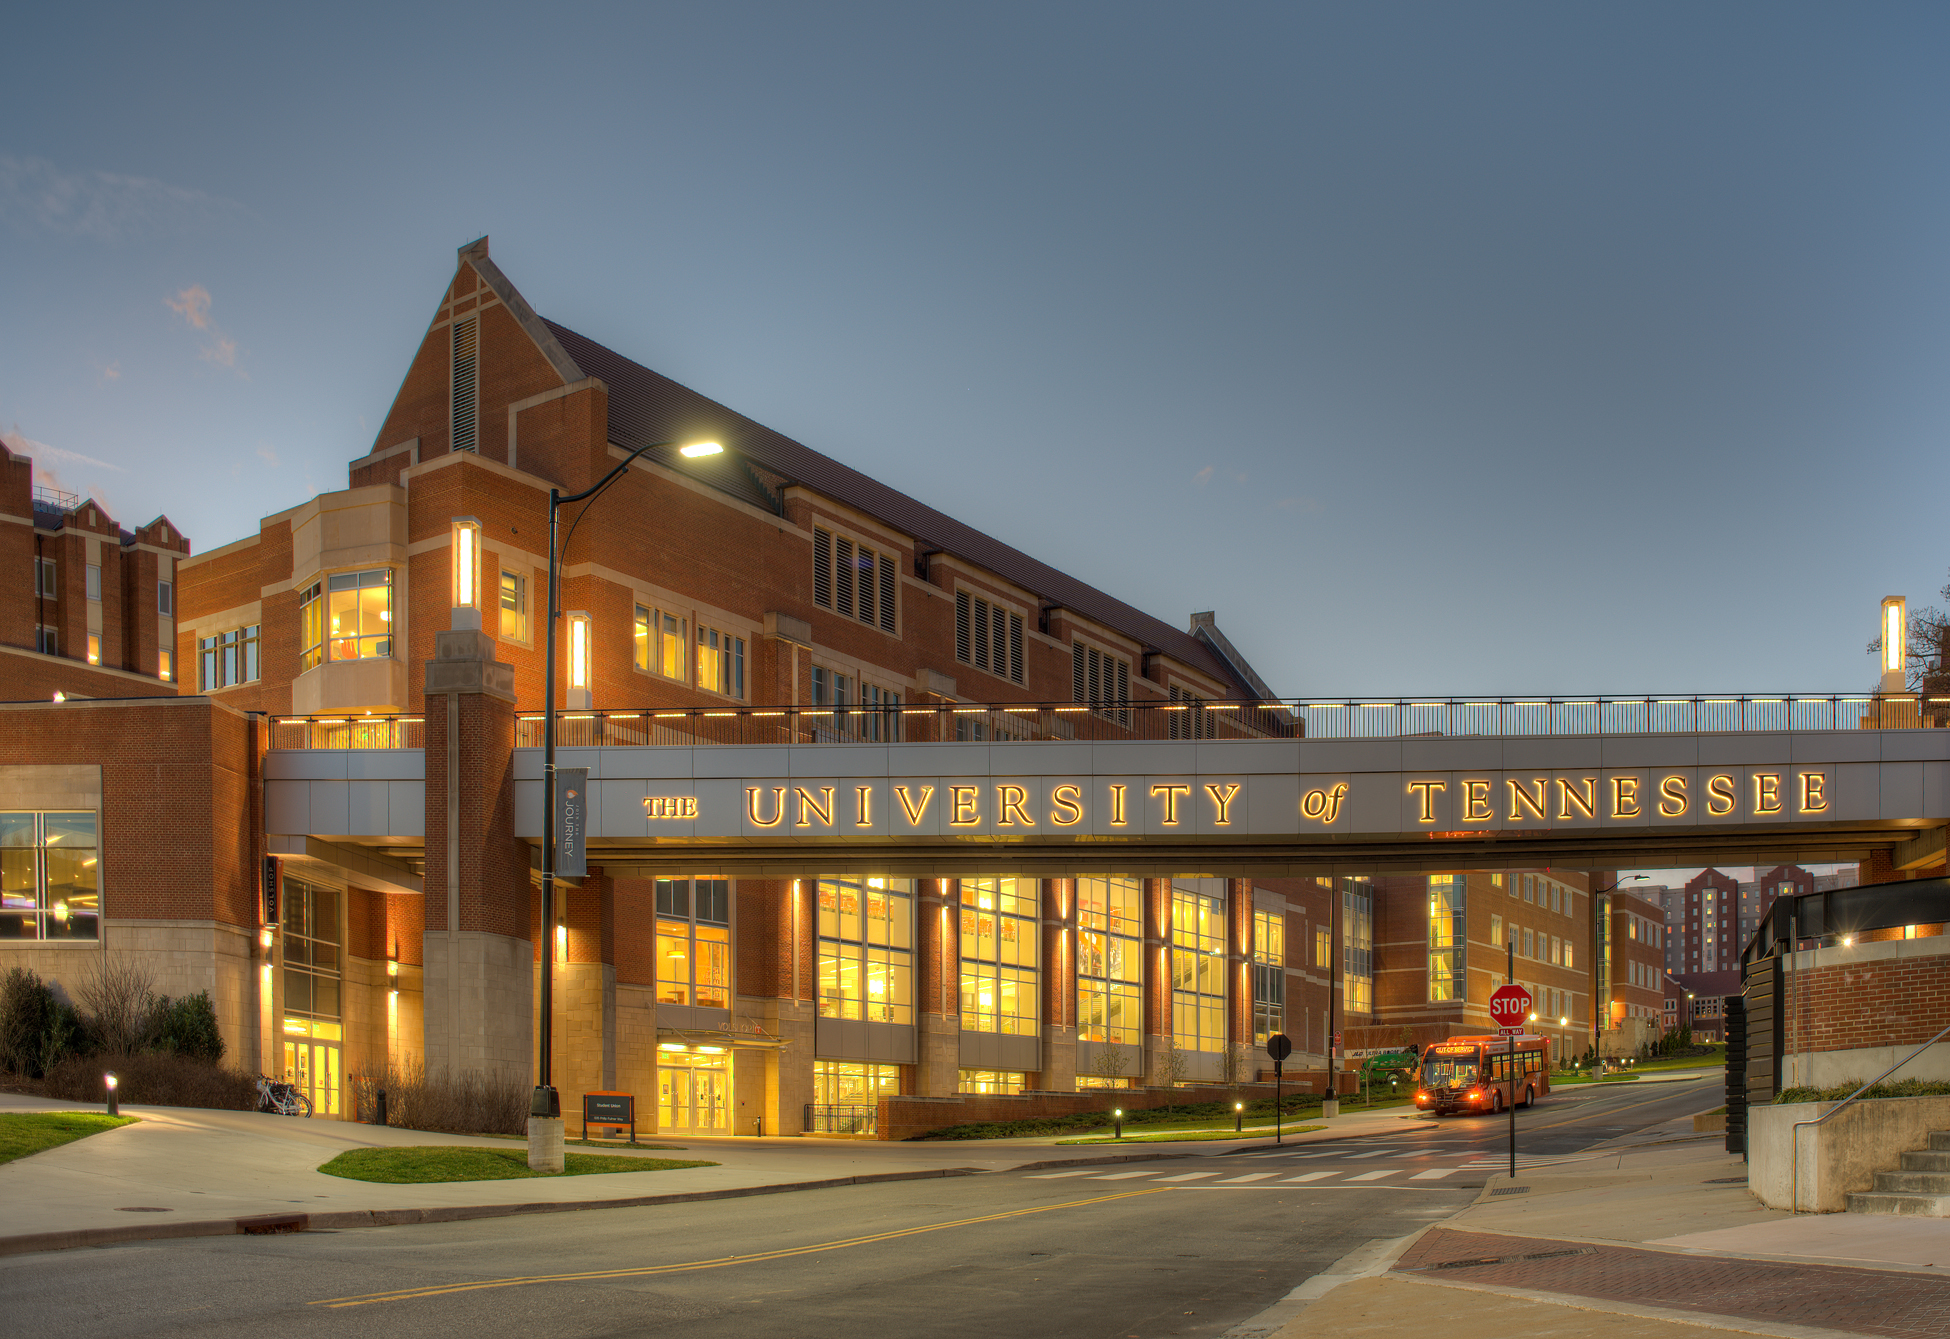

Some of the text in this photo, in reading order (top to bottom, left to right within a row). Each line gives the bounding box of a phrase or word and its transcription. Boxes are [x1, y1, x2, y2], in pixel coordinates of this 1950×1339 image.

[644, 772, 1829, 827] THE UNIVERSITY of TENNESSEE
[564, 801, 574, 857] JOURNEY
[1492, 997, 1530, 1015] STOP
